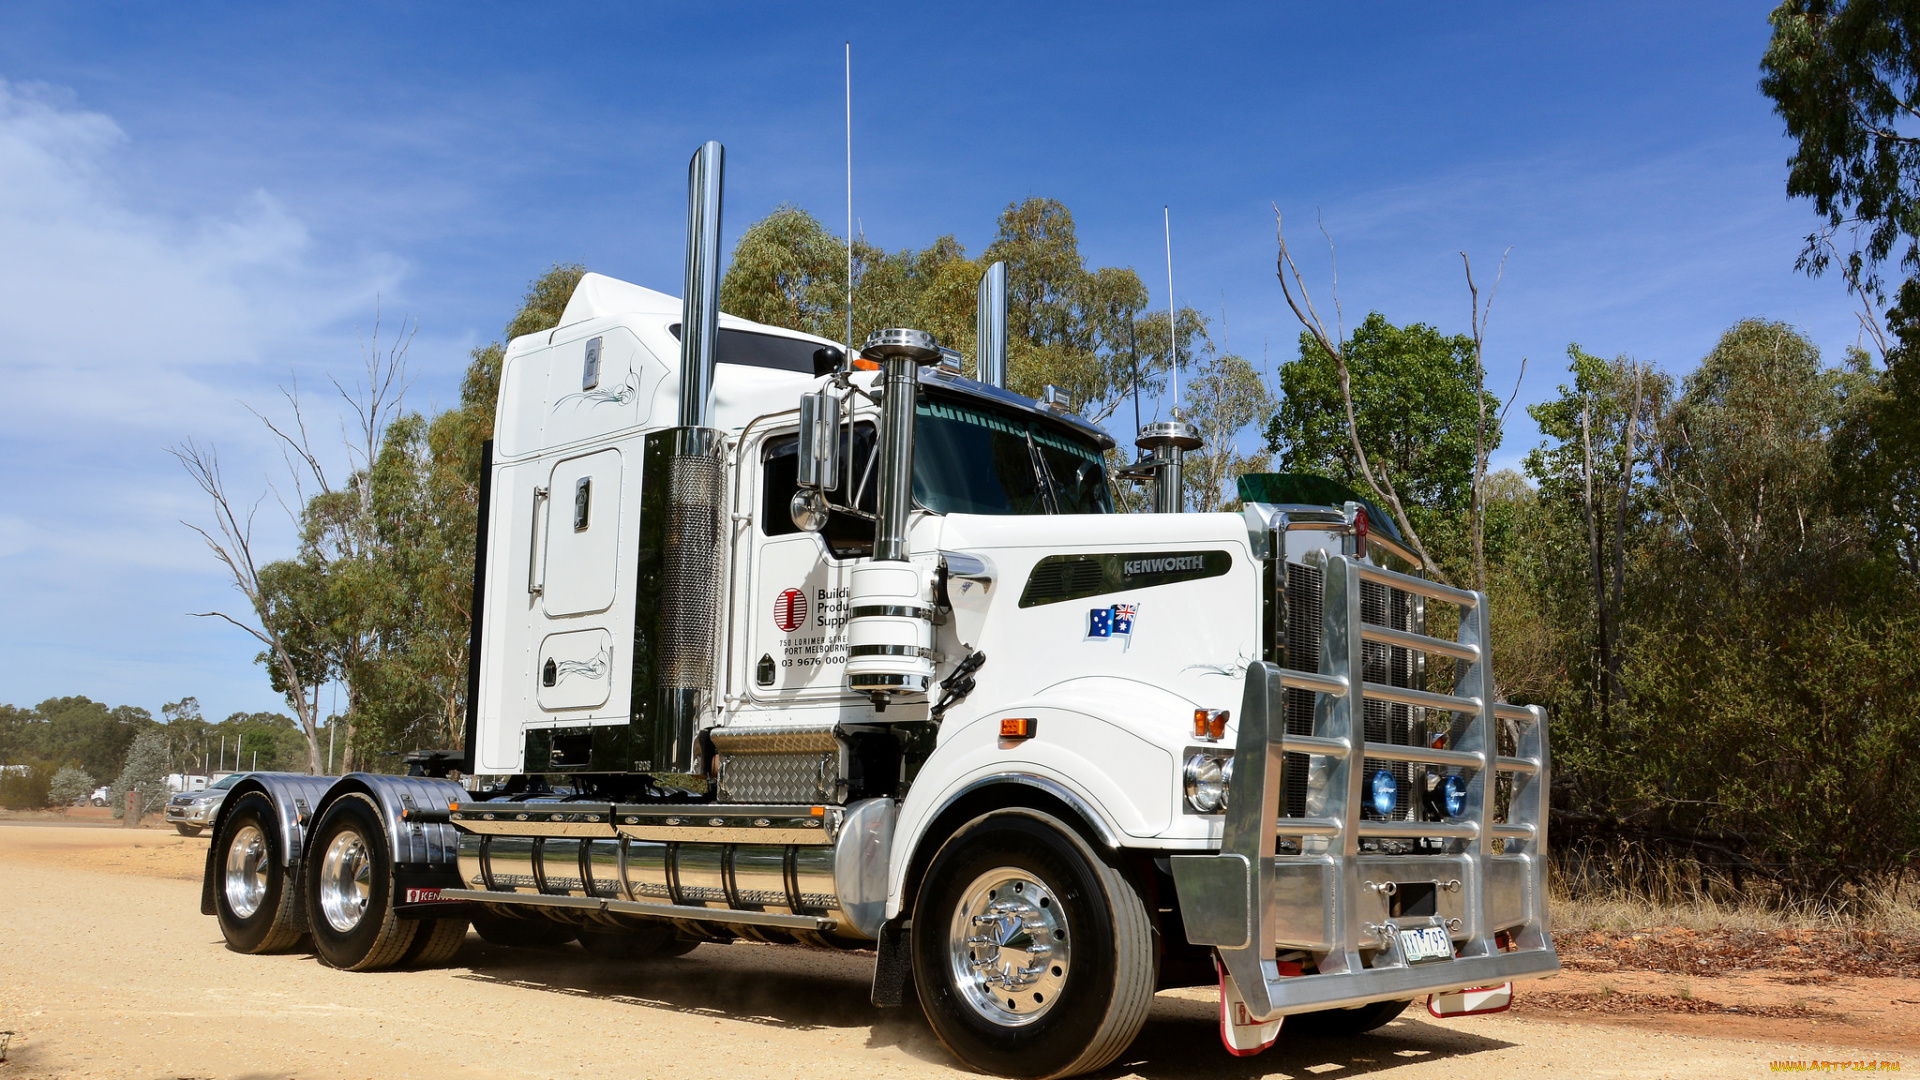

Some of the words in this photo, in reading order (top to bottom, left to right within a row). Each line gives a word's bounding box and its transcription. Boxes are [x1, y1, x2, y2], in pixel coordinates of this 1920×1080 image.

[1124, 555, 1204, 575] KENWORTH
[818, 587, 850, 600] Buildi
[817, 601, 850, 613] Produ
[817, 614, 849, 629] Suppl
[779, 639, 792, 647] 750
[794, 637, 825, 646] LORIMER
[784, 647, 802, 655] PORT
[781, 659, 793, 667] 03
[797, 657, 821, 667] 9676
[825, 655, 848, 665] 000
[1425, 930, 1447, 952] 795
